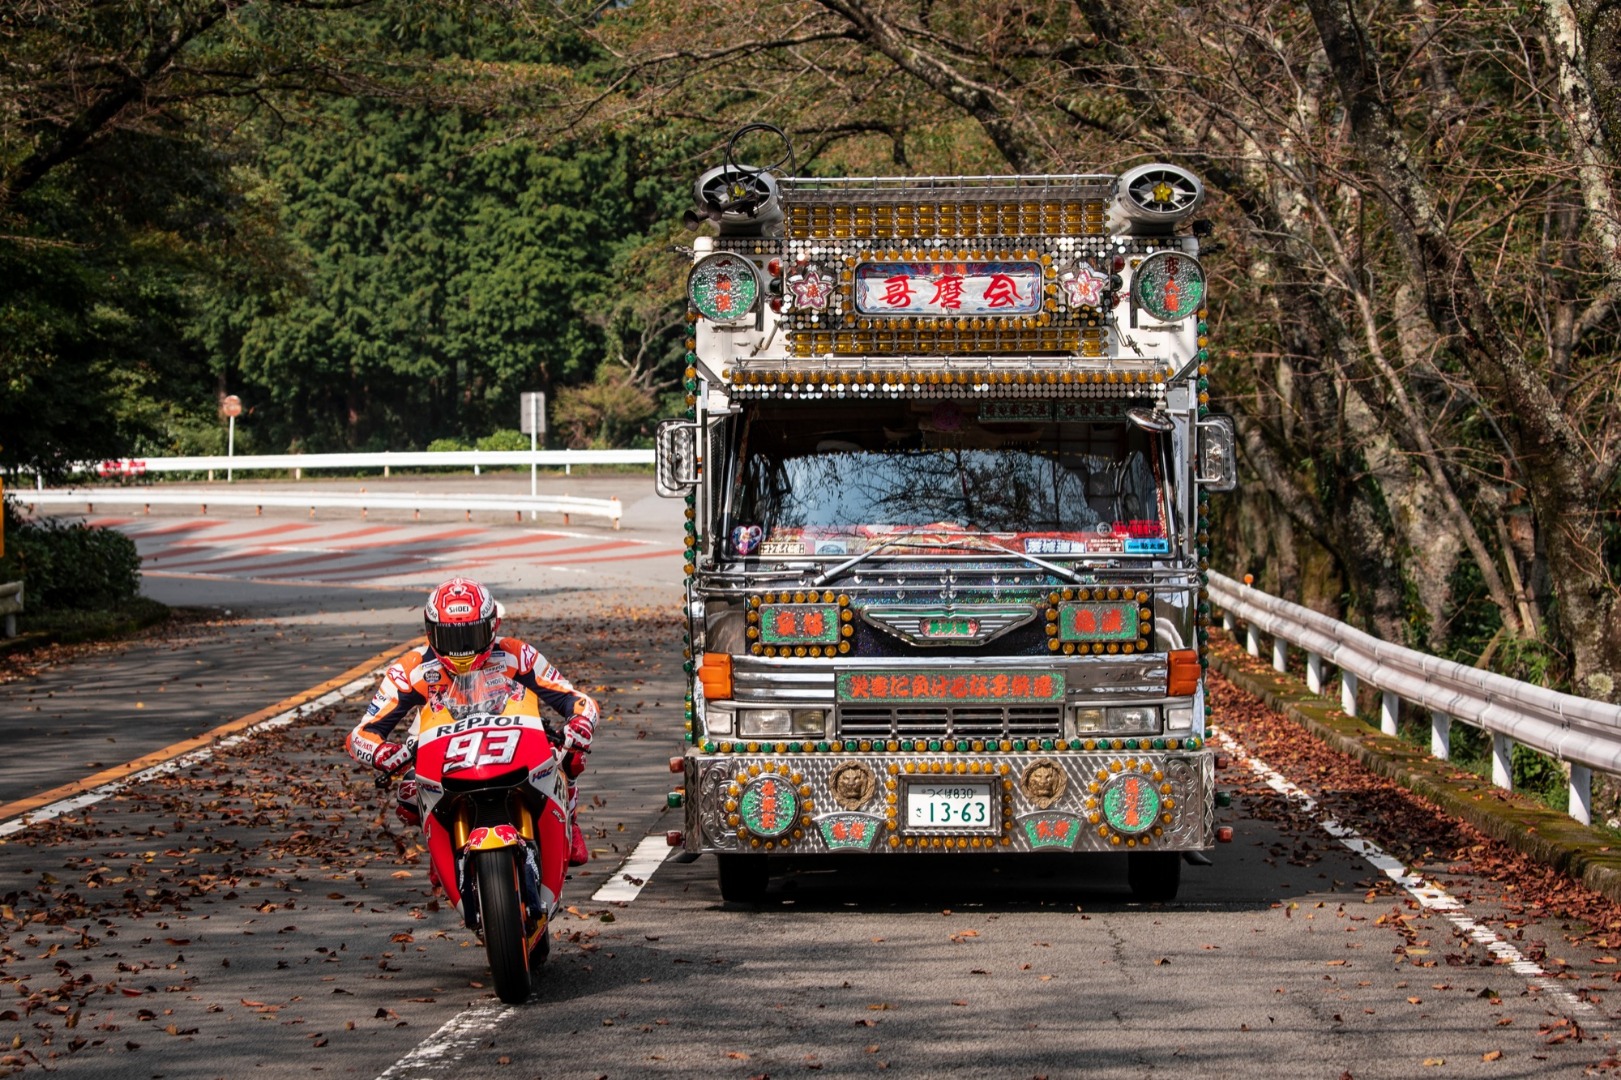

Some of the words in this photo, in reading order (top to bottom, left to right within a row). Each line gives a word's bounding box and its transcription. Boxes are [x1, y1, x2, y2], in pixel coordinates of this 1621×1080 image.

[436, 716, 524, 738] REPSOL
[442, 728, 523, 774] 93
[532, 766, 554, 783] HRC
[930, 802, 985, 823] 13-63
